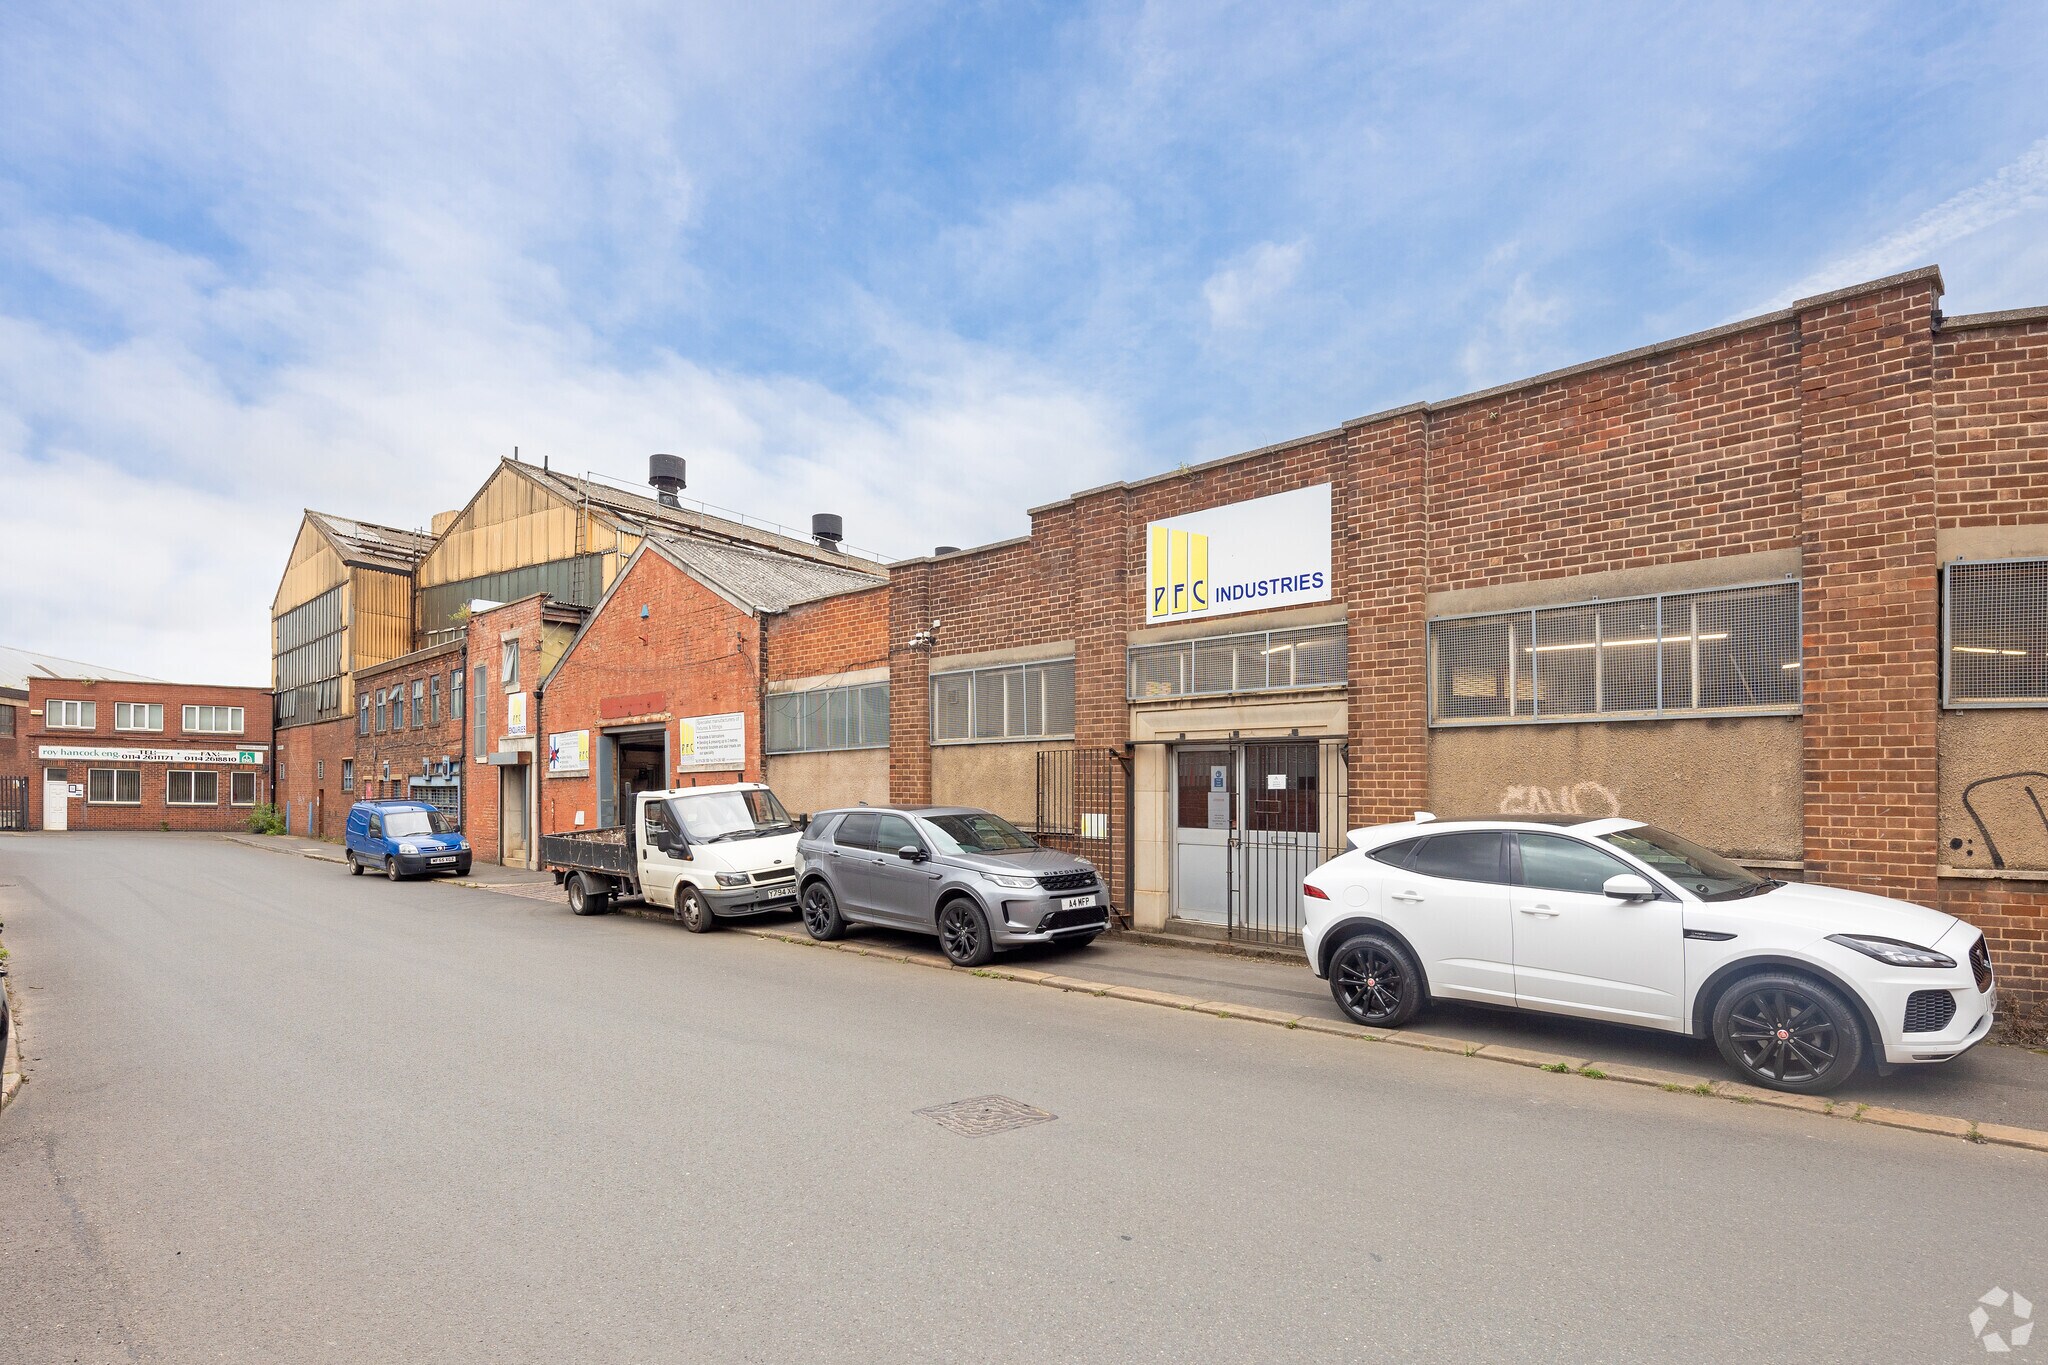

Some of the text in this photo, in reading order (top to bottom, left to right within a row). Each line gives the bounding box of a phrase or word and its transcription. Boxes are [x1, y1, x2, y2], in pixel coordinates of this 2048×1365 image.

[1216, 571, 1324, 603] INDUSTRIES
[42, 749, 59, 757] roy
[60, 748, 100, 757] hancock
[1043, 868, 1088, 876] DISCOVERY
[1068, 897, 1090, 908] A4 MFP
